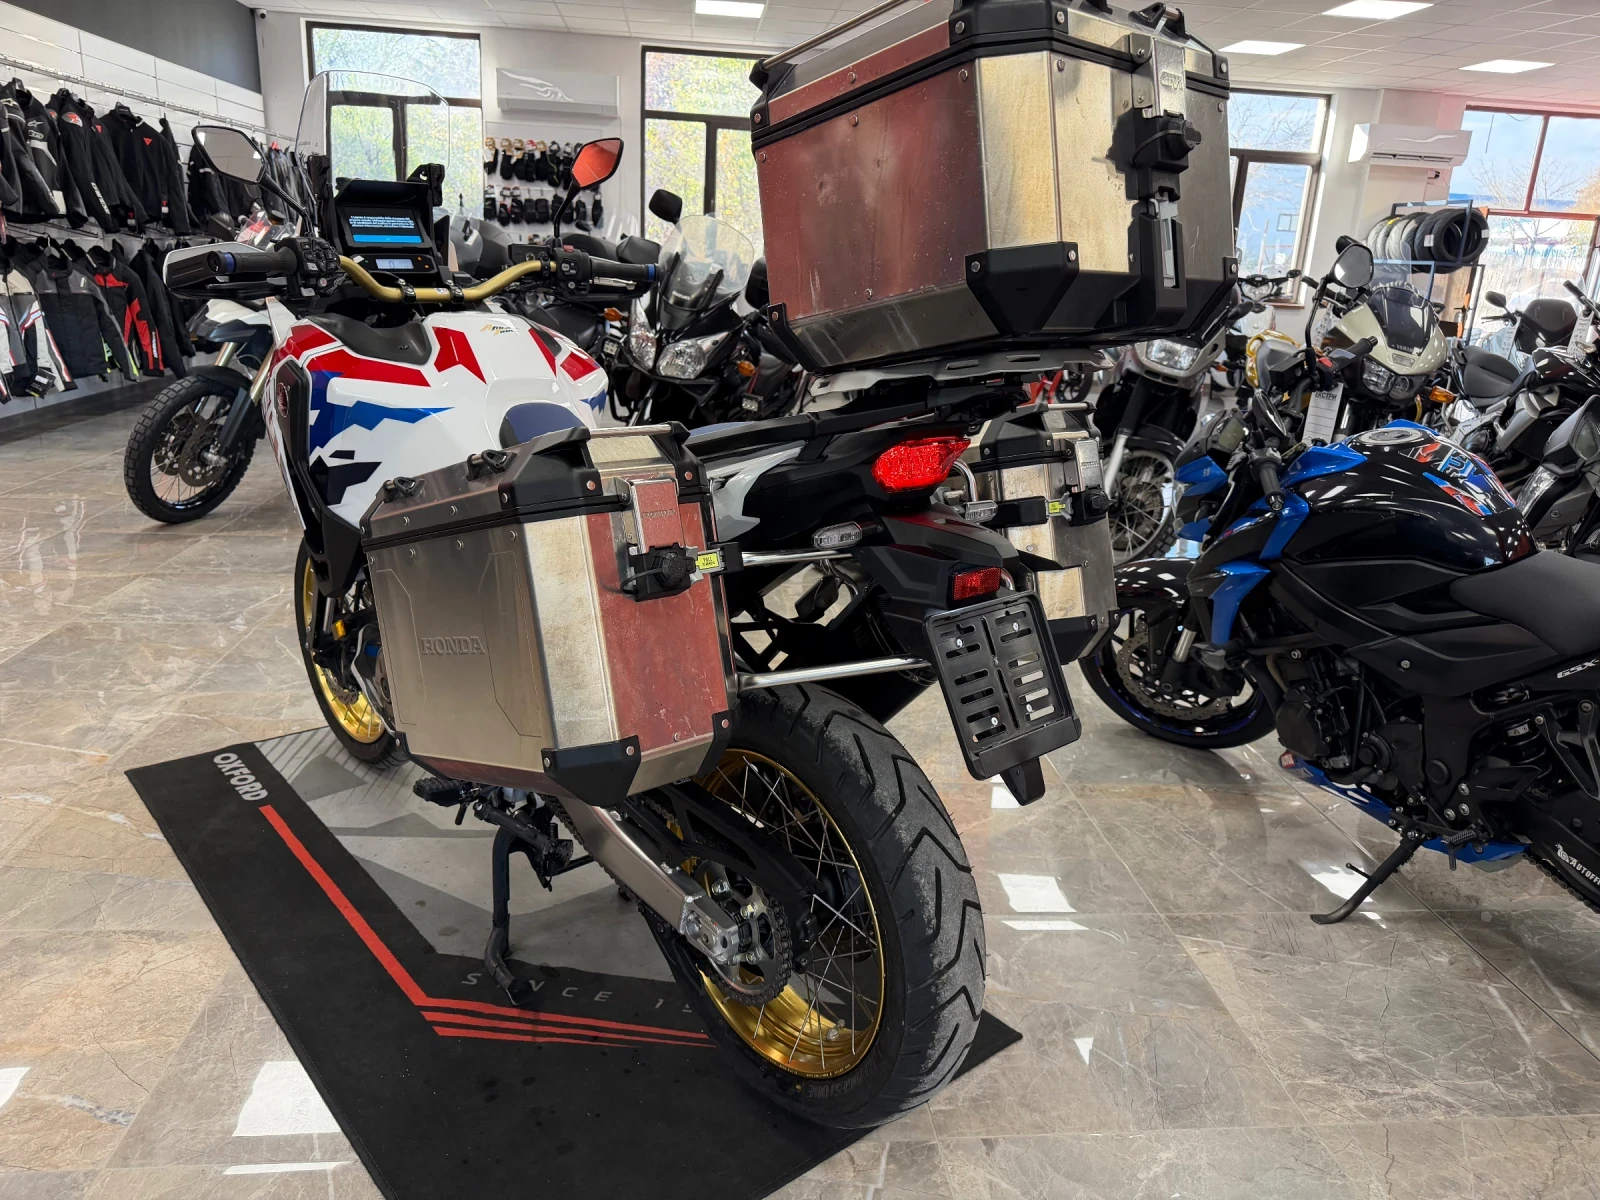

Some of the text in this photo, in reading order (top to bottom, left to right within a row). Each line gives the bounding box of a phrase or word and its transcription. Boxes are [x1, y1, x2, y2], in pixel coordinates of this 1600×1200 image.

[421, 635, 487, 656] HONDA
[213, 752, 269, 801] OXFORD
[461, 972, 613, 1002] SNCE
